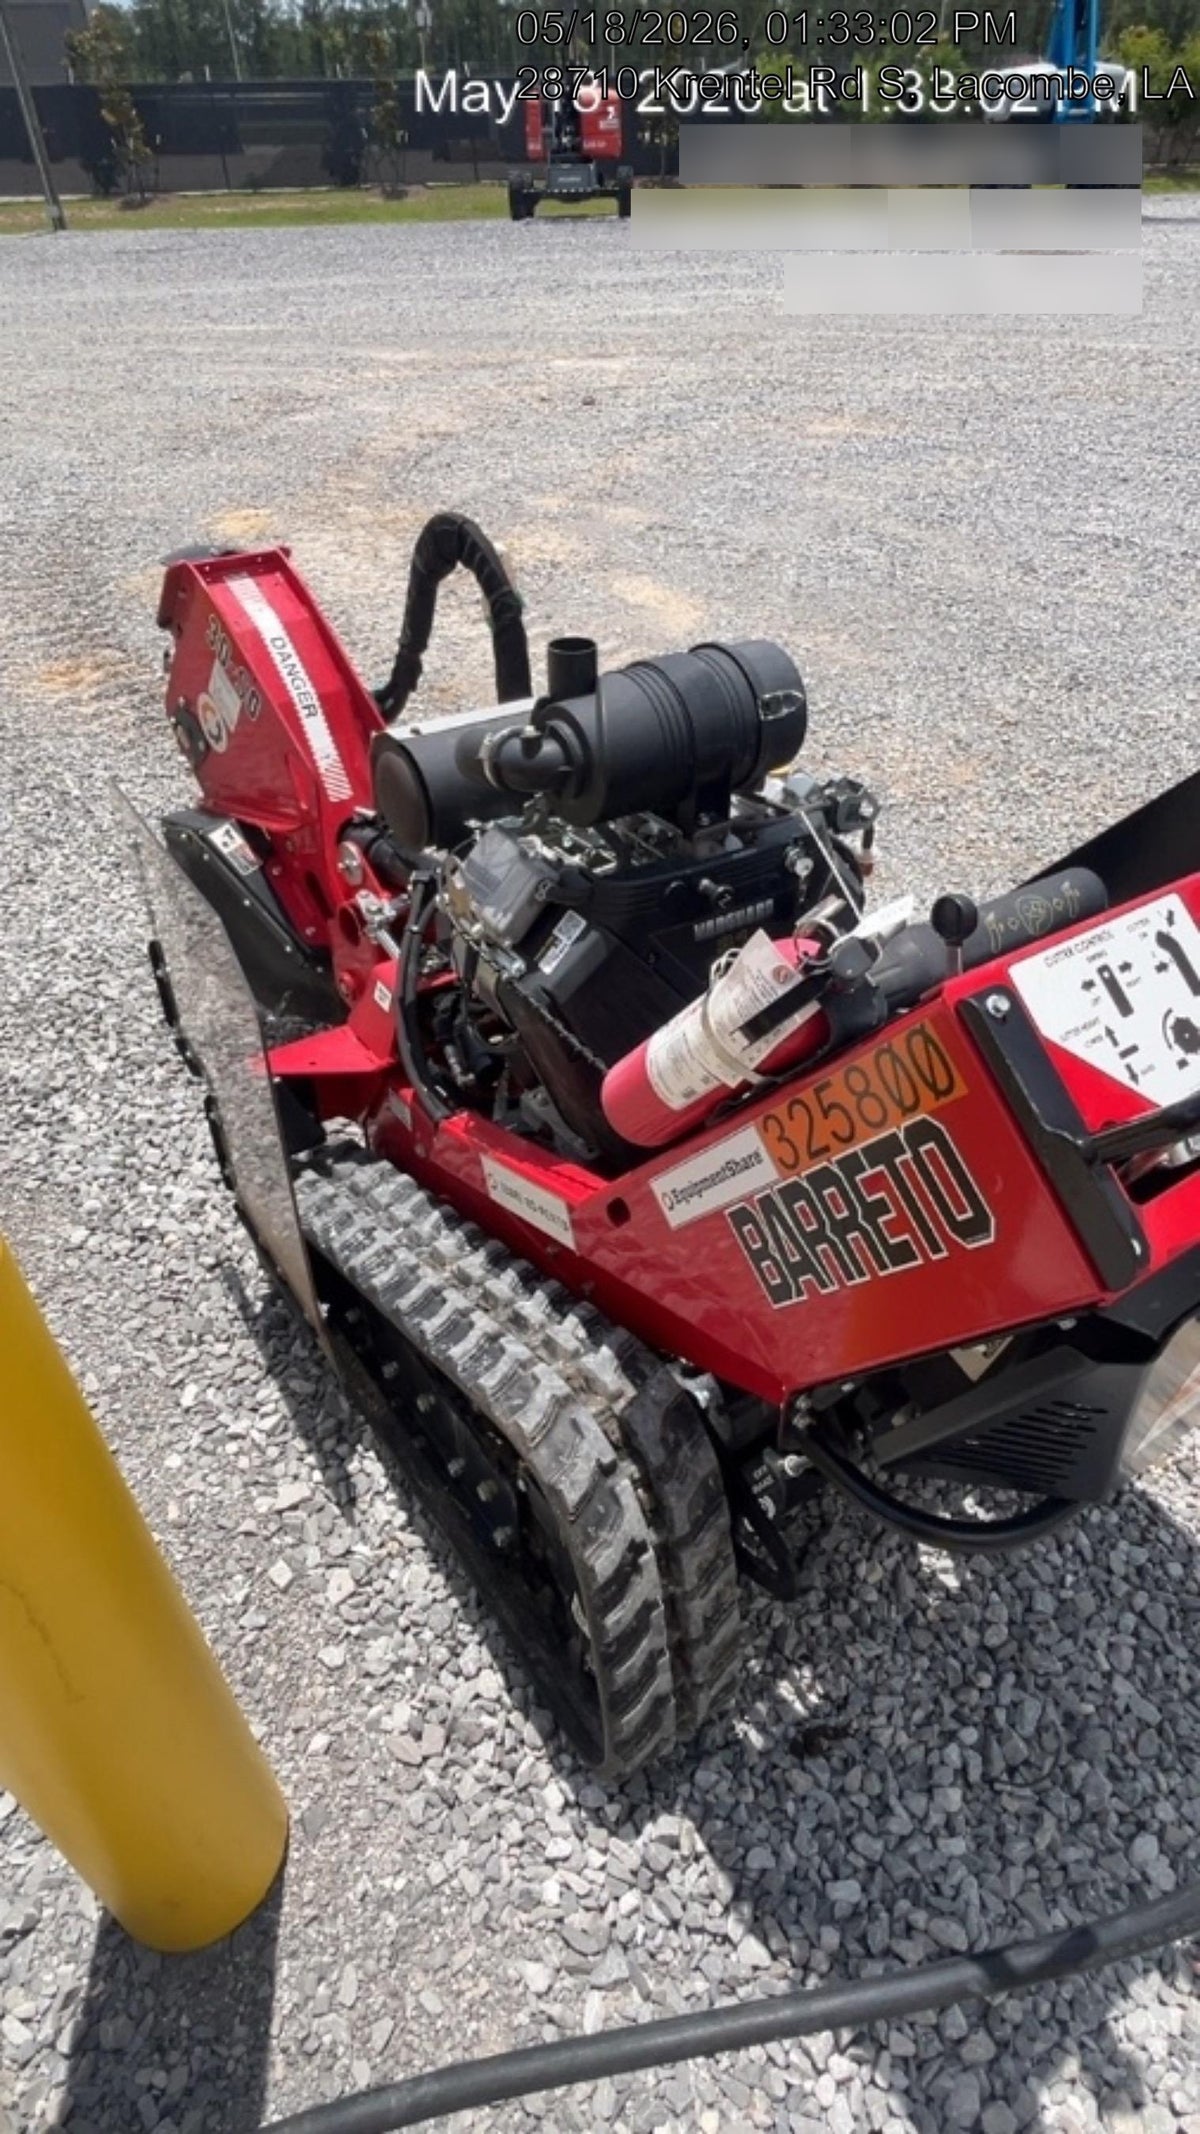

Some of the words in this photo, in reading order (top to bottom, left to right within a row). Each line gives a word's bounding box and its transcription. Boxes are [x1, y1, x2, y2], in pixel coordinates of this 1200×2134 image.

[268, 636, 319, 721] DANGER
[761, 1023, 956, 1171] 325800
[671, 1149, 764, 1205] EquipmentShare
[724, 1113, 995, 1309] BARRETO
